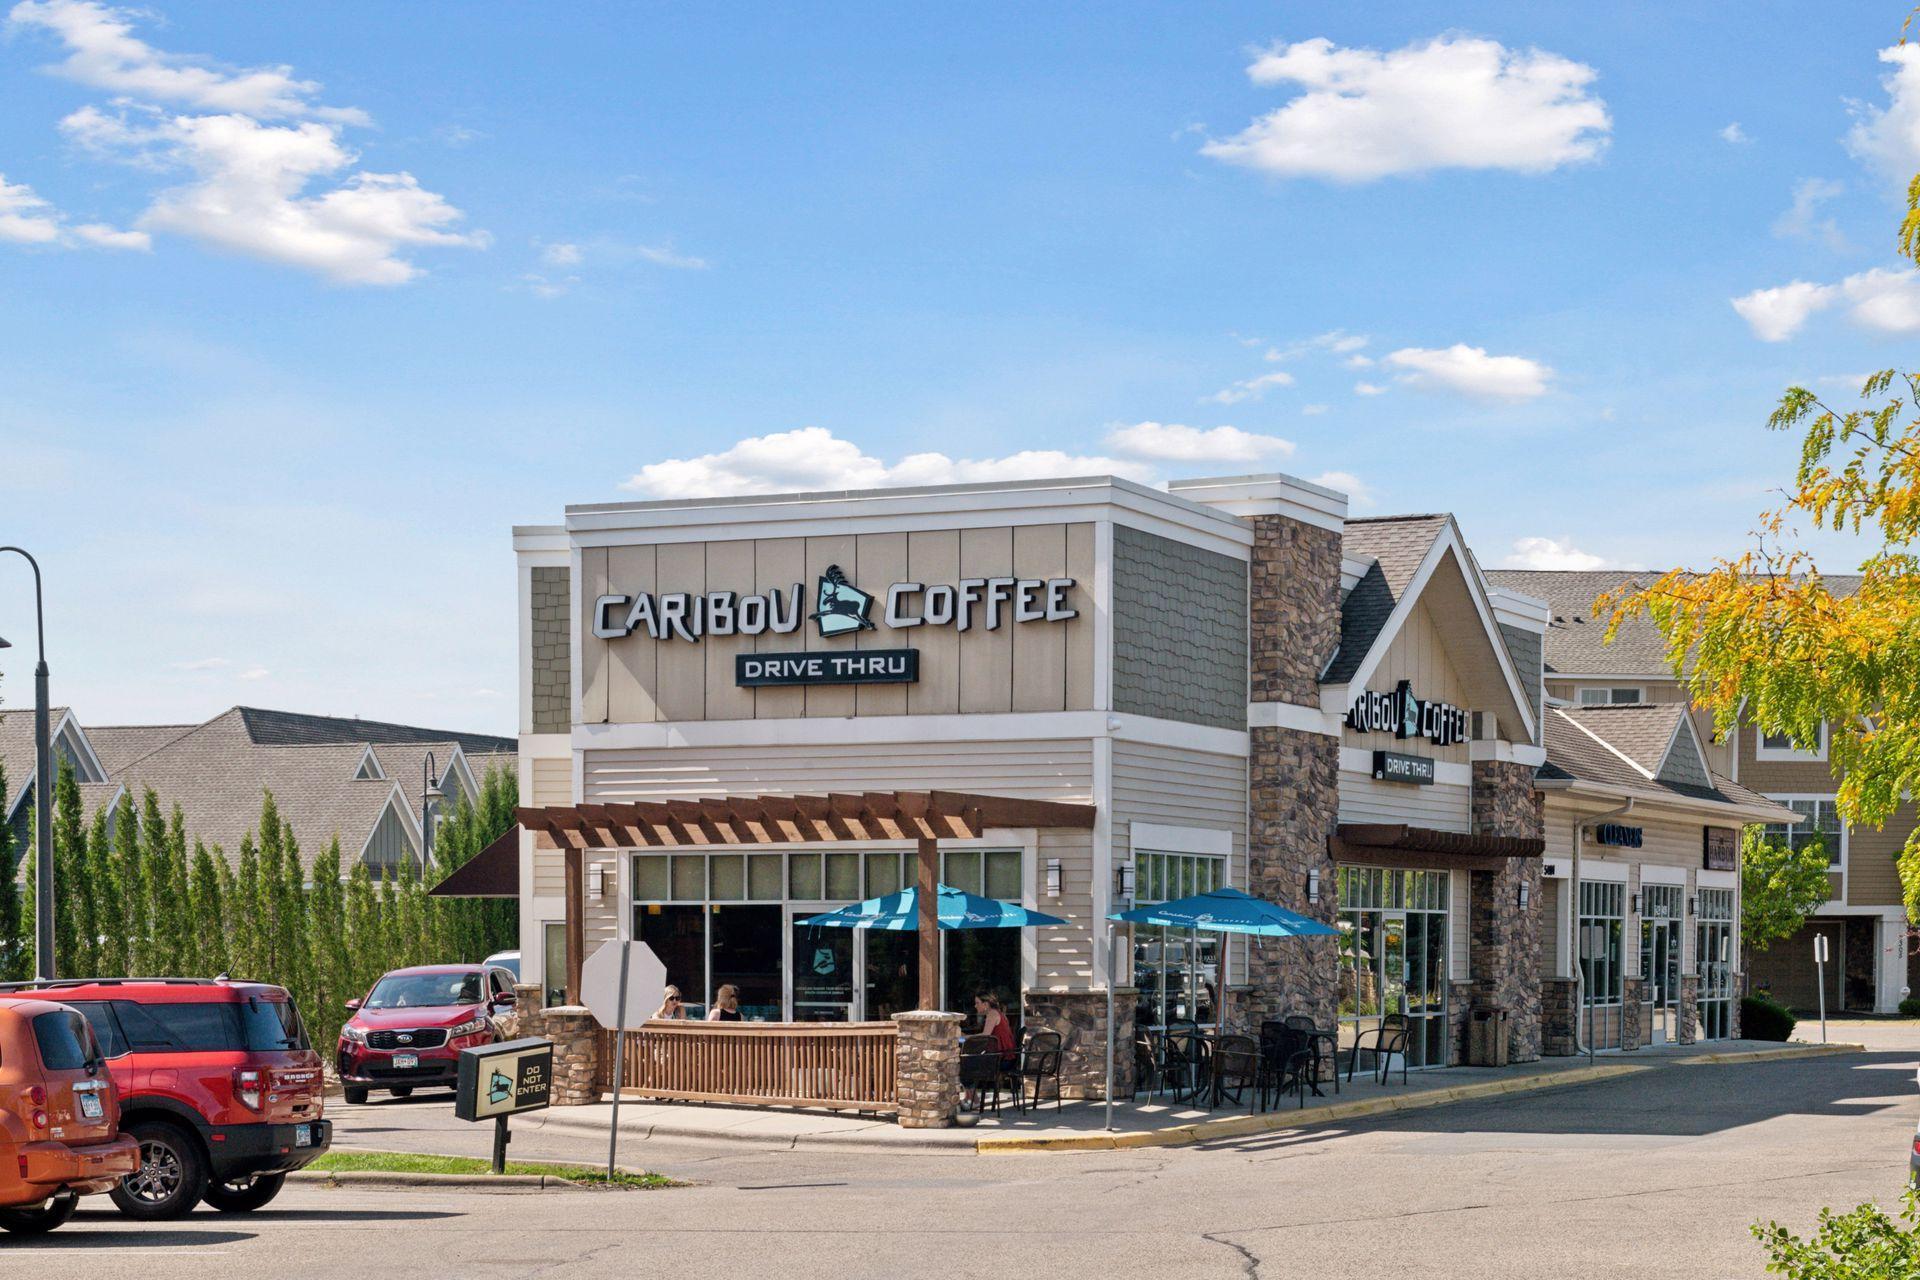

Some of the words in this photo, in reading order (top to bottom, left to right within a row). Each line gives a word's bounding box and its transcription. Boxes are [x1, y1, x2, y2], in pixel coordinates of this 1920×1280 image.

[592, 583, 804, 643] CARIBOU
[884, 577, 1080, 633] COFFEE
[745, 659, 822, 678] DRIVE
[831, 656, 905, 676] THRU
[1420, 700, 1471, 746] COFFEE
[1387, 758, 1410, 775] DRIVE
[1412, 761, 1432, 778] THRU
[523, 1074, 542, 1085] NOT
[526, 1066, 540, 1075] DO
[517, 1083, 547, 1096] ENTER
